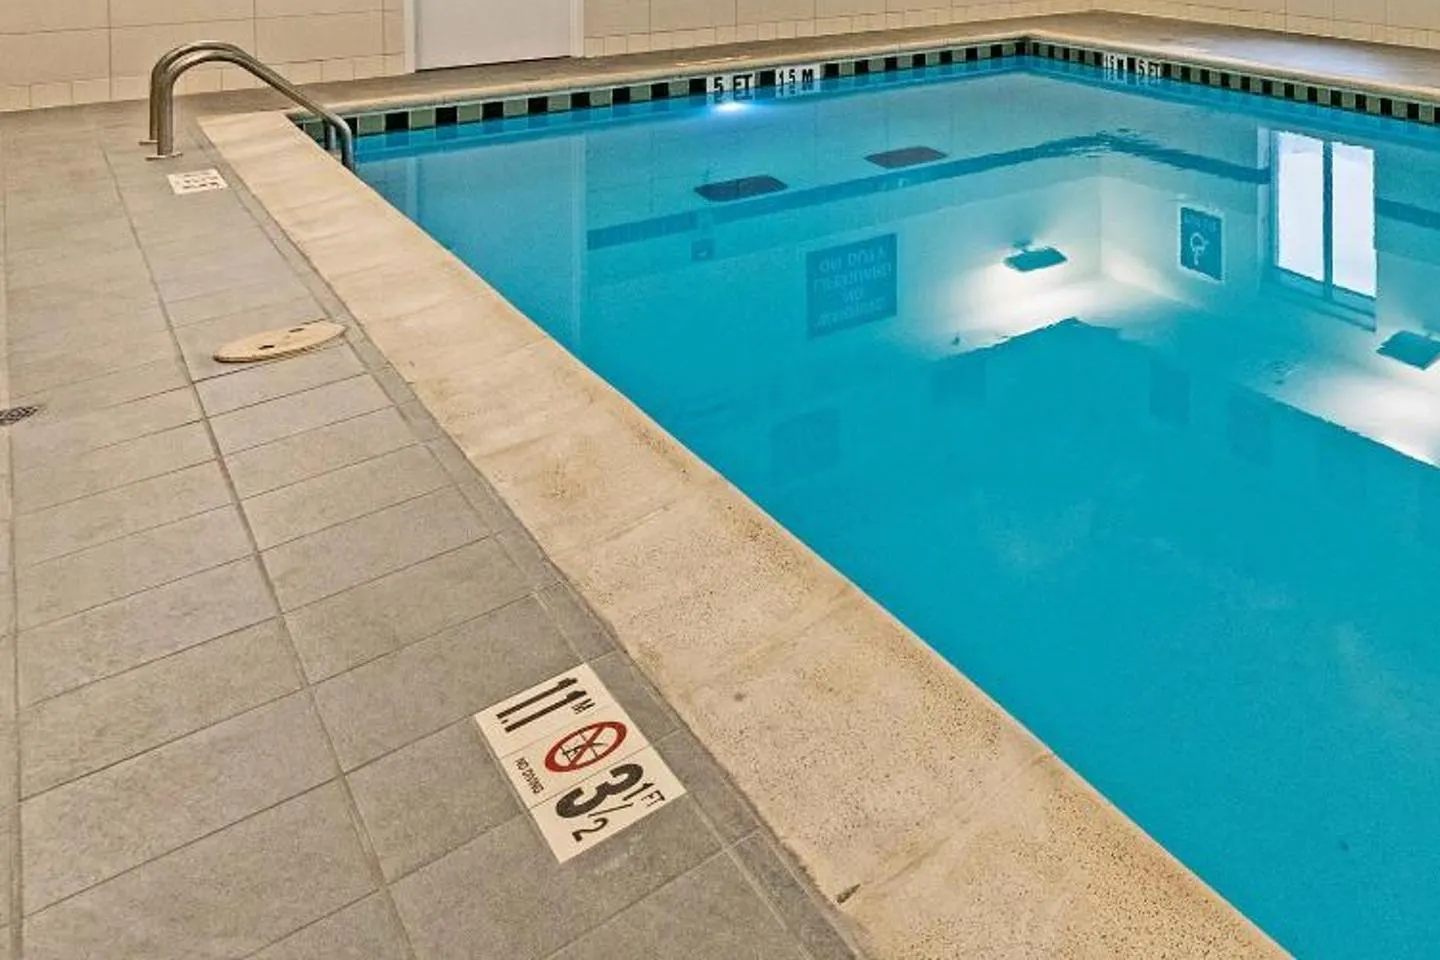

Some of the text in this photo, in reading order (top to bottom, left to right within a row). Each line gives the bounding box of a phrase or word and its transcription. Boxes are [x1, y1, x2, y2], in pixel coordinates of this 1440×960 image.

[713, 74, 754, 92] 5 FT
[802, 68, 814, 83] M
